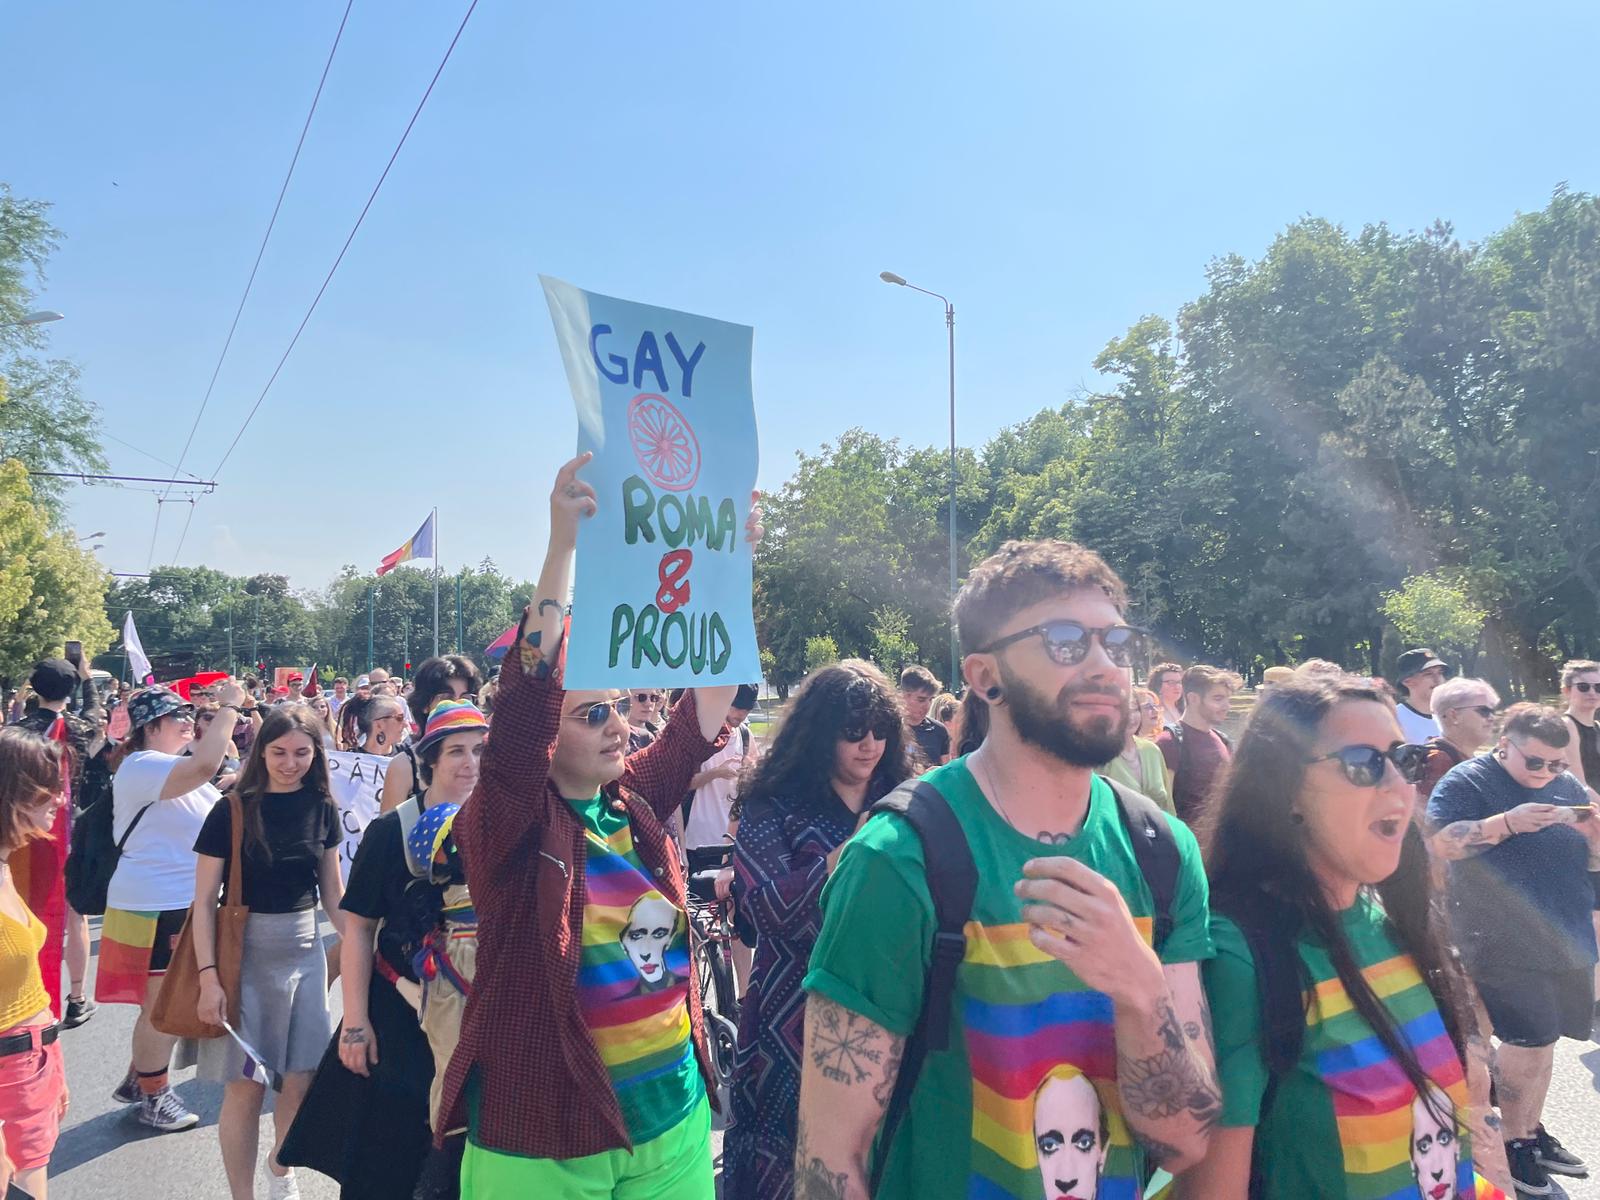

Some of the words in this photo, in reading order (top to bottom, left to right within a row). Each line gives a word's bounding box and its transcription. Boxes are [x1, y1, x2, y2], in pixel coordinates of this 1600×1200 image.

[588, 323, 706, 398] GAY
[622, 474, 736, 553] ROMA
[655, 548, 692, 614] &
[608, 603, 731, 675] PROUD
